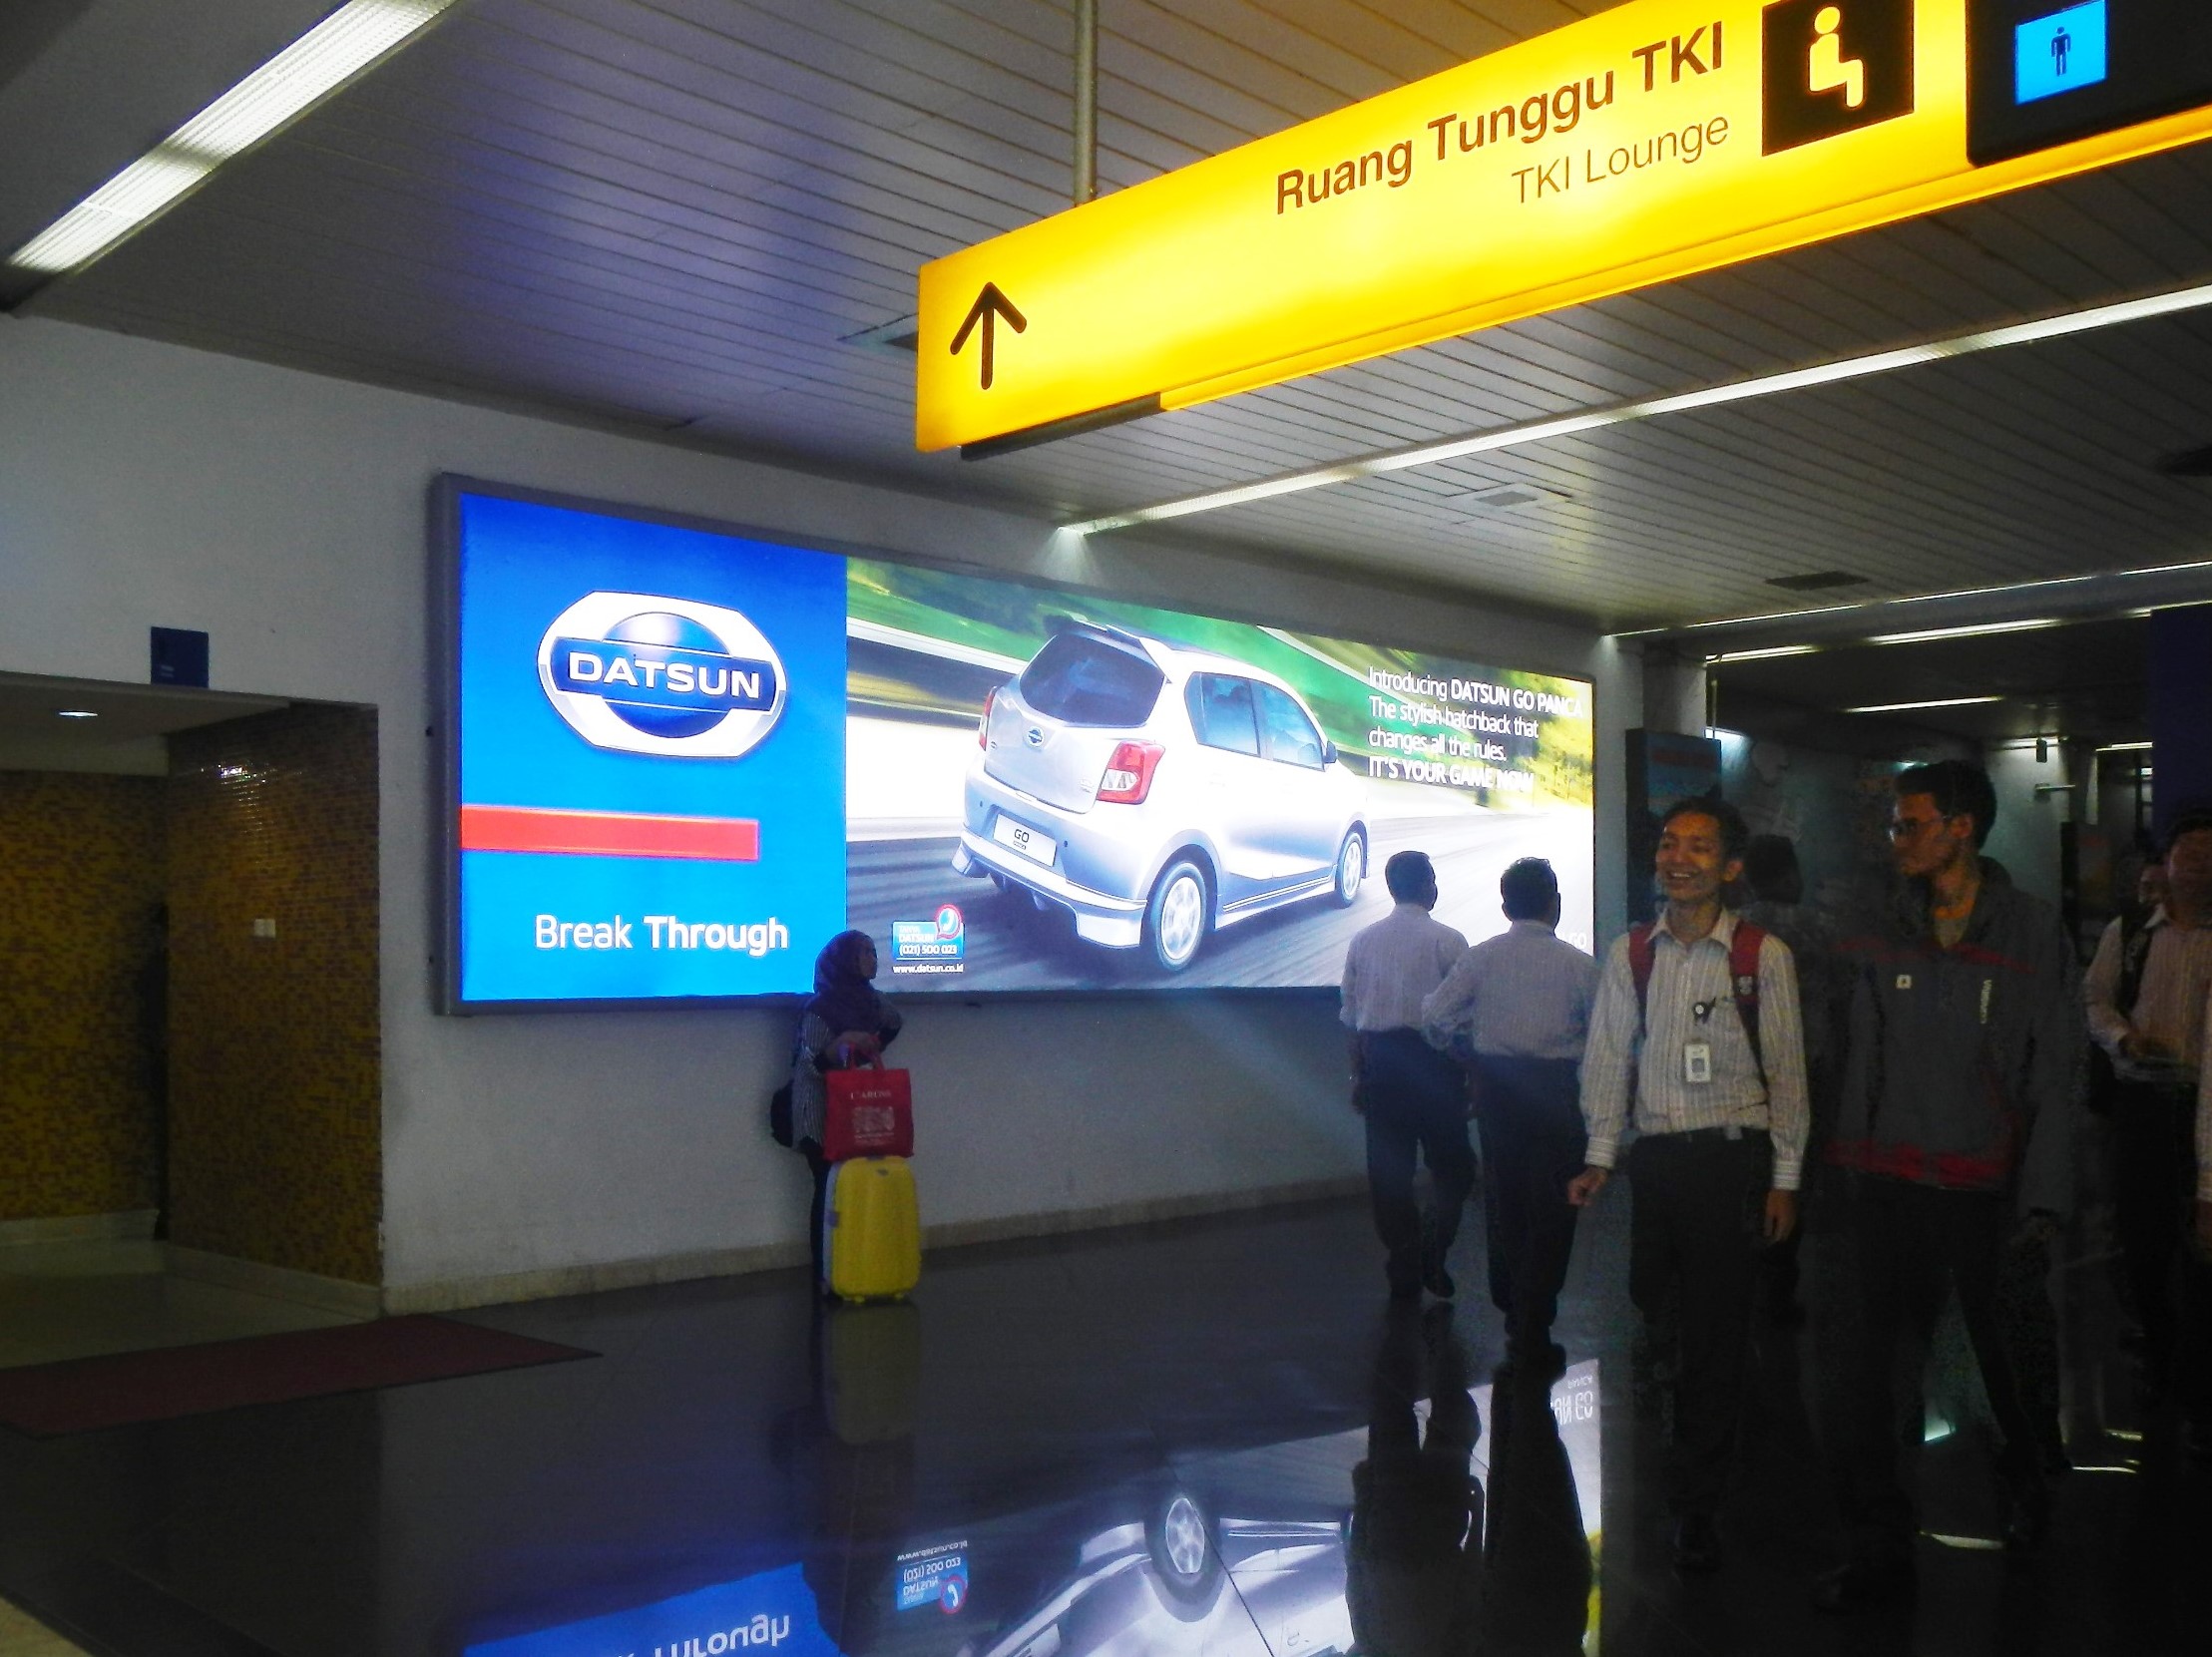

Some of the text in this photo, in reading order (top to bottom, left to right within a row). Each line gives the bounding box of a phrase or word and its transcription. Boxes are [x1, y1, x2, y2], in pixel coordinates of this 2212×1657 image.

[1277, 21, 1723, 214] Ruang Tunggu TKI
[1512, 116, 1729, 205] TKI Lounge
[569, 651, 760, 699] DATSUN
[1368, 666, 1582, 717] Introducing DATSUN GO PANCA
[1368, 695, 1540, 738] The stylish hatchback that
[1368, 726, 1507, 761] changes all the rules.
[1368, 756, 1535, 792] IT'S YOUR GAME NOW
[1014, 828, 1030, 843] GO
[534, 914, 788, 957] Break Through
[892, 964, 964, 974] www.datsun.co.id
